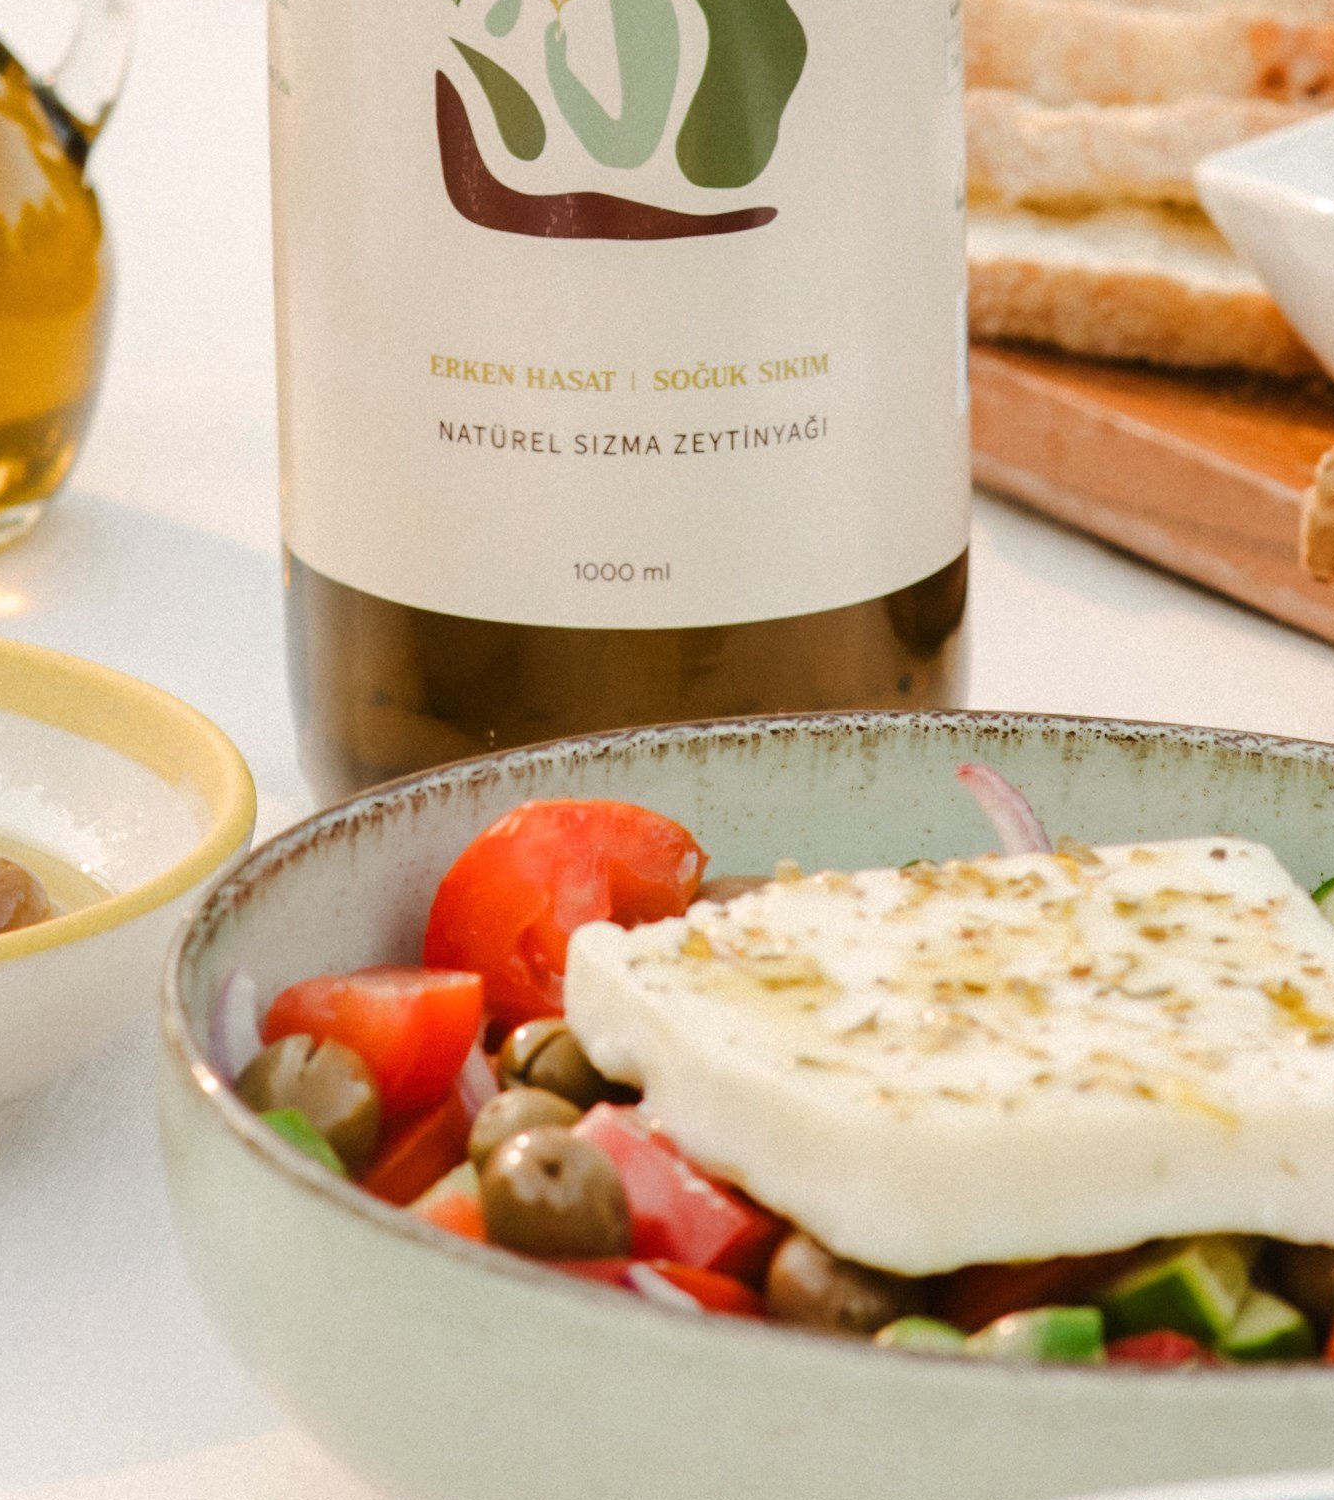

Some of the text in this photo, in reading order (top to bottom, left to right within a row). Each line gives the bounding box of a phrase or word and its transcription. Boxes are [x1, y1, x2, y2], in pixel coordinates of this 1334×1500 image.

[430, 353, 829, 392] ERKEN HASAT SOĞUK SIKIM
[439, 416, 828, 455] NATÜREL SIZMA ZEYTİNYAĞI
[573, 562, 670, 581] 1000 ml
